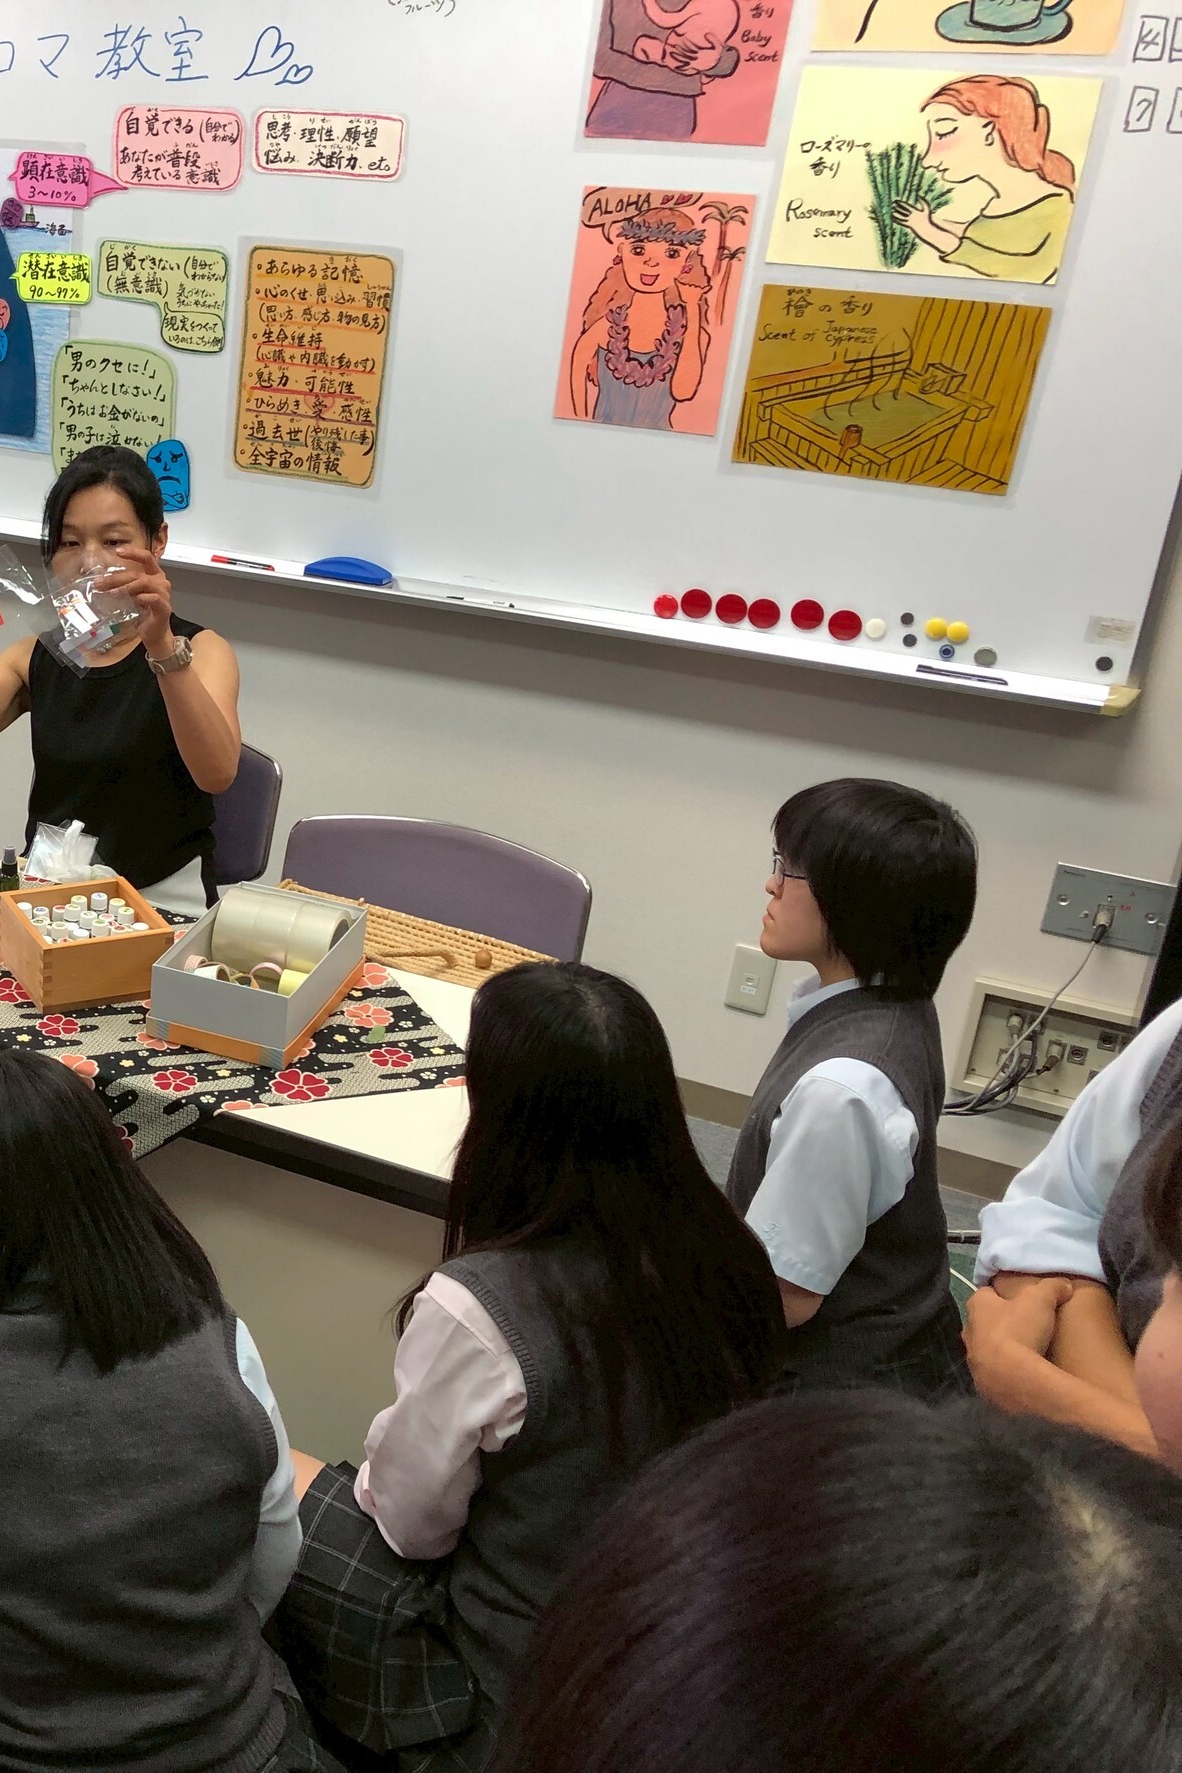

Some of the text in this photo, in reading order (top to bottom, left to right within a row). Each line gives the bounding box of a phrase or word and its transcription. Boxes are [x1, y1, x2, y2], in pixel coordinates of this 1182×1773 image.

[741, 29, 772, 48] Baby
[126, 112, 194, 136] 自覚できる
[120, 147, 201, 169] あなたが普段
[809, 156, 840, 179] 香り
[20, 160, 89, 187] 顕在意識
[588, 192, 651, 222] ALOHA
[786, 198, 852, 223] Rosemary
[813, 226, 853, 238] scent
[22, 259, 90, 283] 潜在意識
[106, 251, 180, 272] 自覚できない
[758, 320, 877, 342] Scent of Japanese
[825, 334, 874, 347] cypress
[249, 446, 343, 476] 全宇宙の情報
